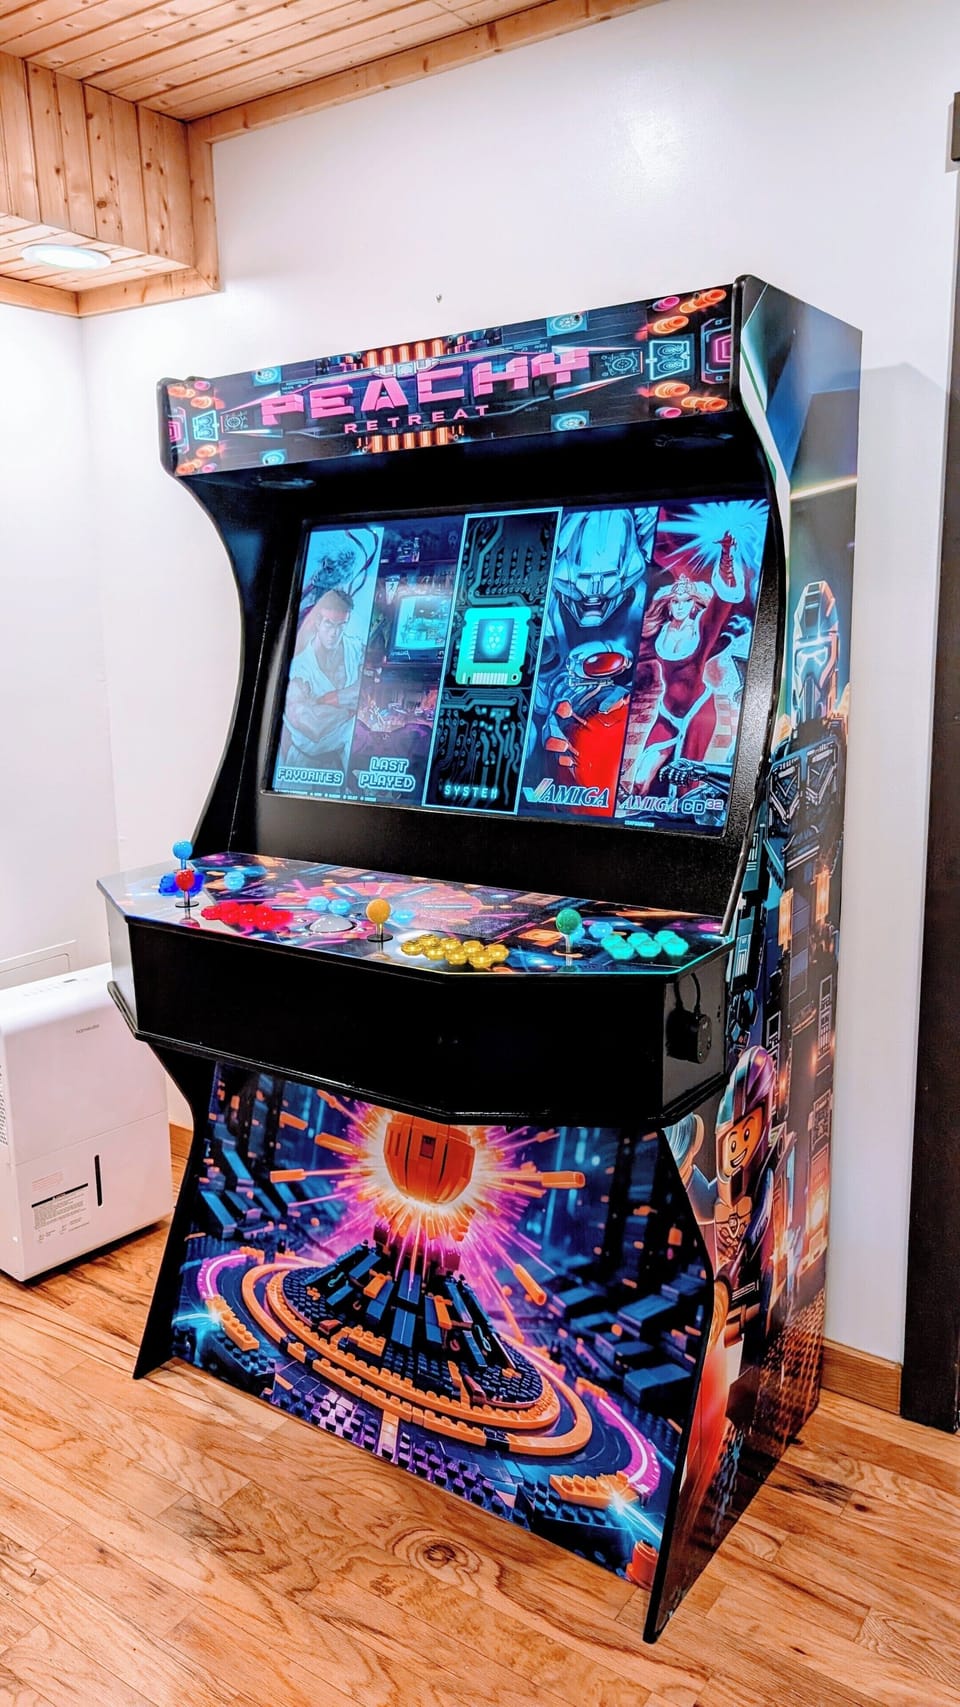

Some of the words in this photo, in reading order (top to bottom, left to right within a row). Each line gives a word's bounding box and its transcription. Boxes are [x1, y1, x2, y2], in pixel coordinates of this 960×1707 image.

[260, 349, 590, 426] PEACHY
[344, 405, 490, 434] RETREAT
[370, 757, 409, 773] LAST
[277, 767, 343, 786] FAVORITES
[359, 772, 415, 790] PLAYED
[443, 784, 499, 799] SYSTEM
[539, 784, 610, 808] AMIGA
[618, 794, 679, 814] AMIGA
